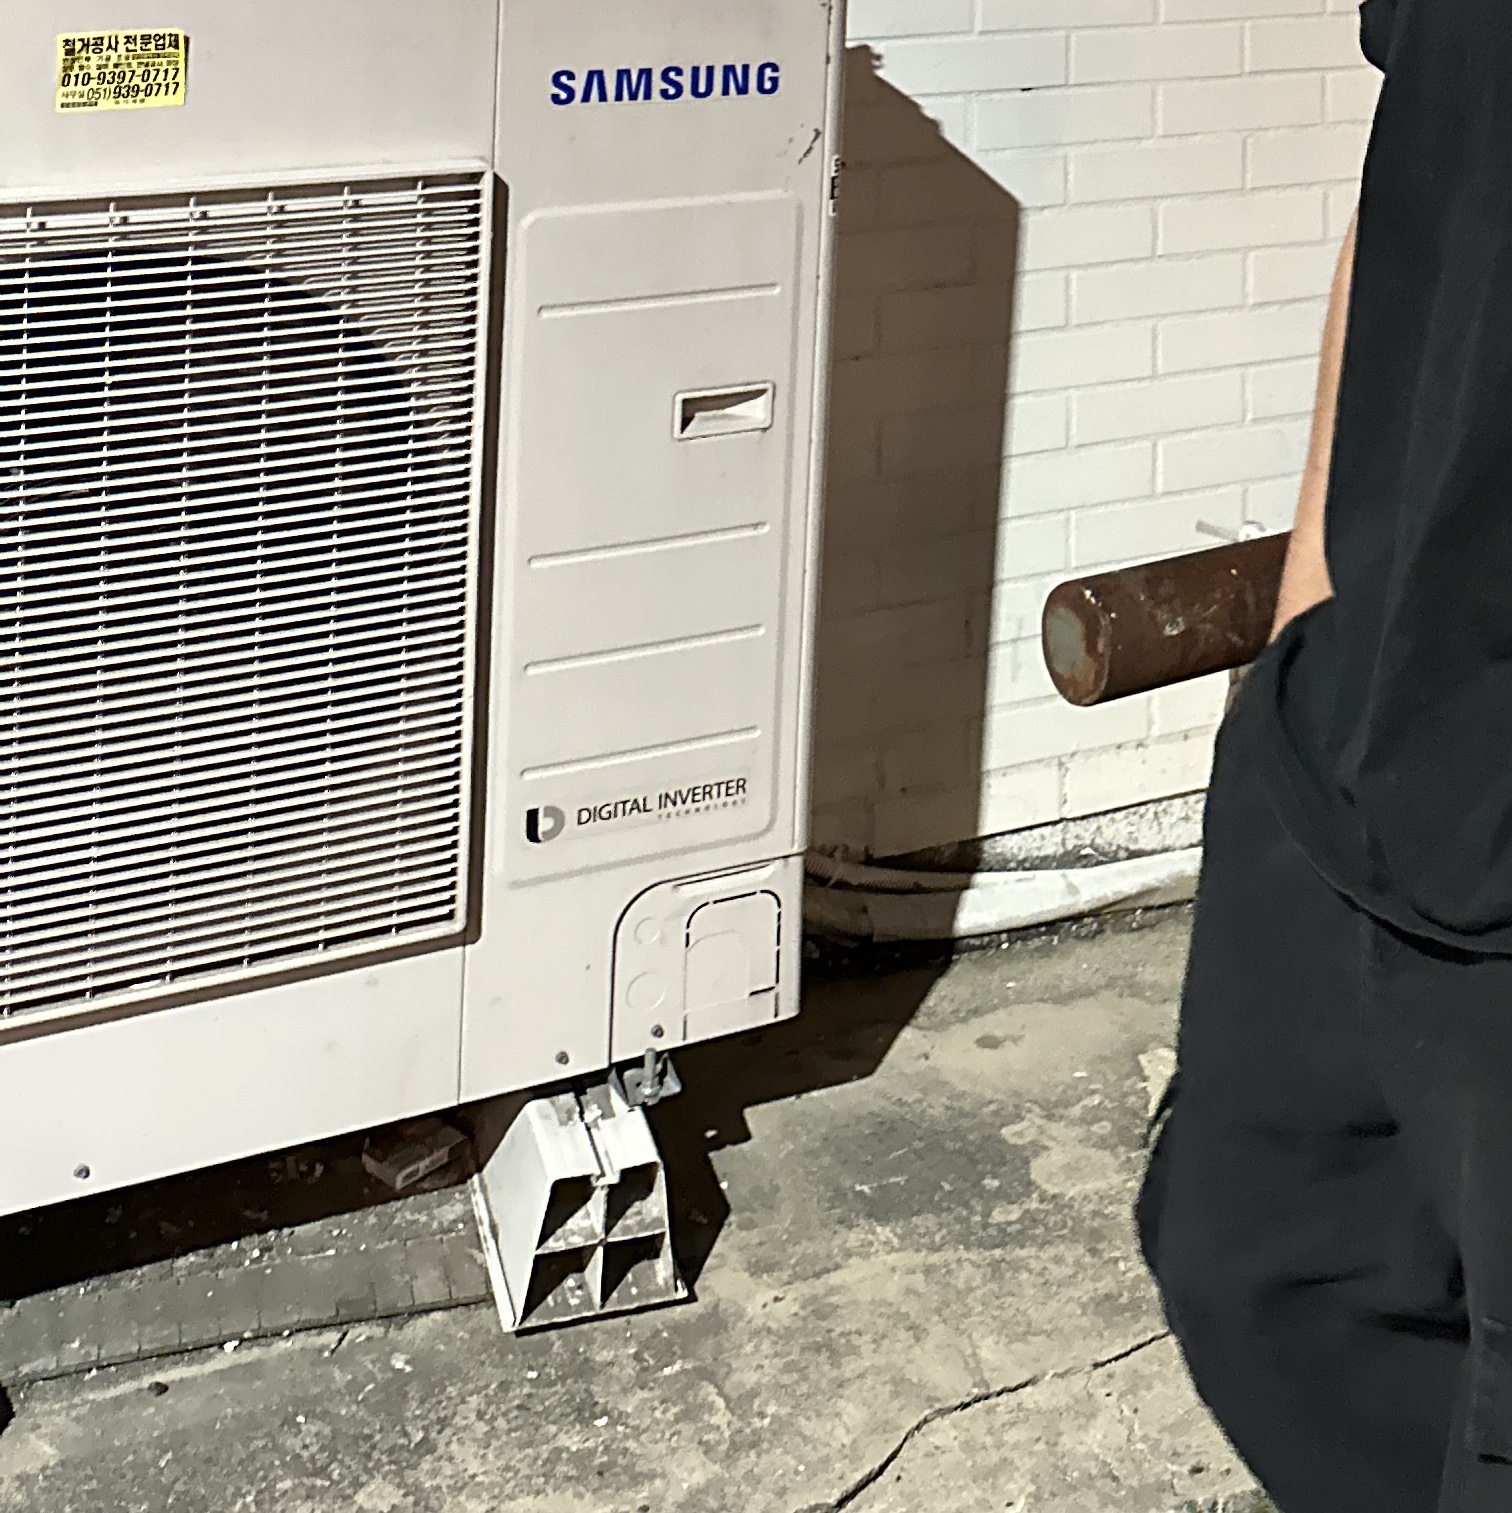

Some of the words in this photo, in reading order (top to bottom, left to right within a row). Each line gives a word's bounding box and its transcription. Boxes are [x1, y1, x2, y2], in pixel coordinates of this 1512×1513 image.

[62, 34, 120, 56] 철거공사
[123, 33, 180, 52] 전문업체
[61, 68, 180, 87] 010-9397-0717
[550, 62, 780, 105] SAMSUNG
[576, 796, 652, 826] DIGITAL
[658, 778, 747, 810] INVERTER
